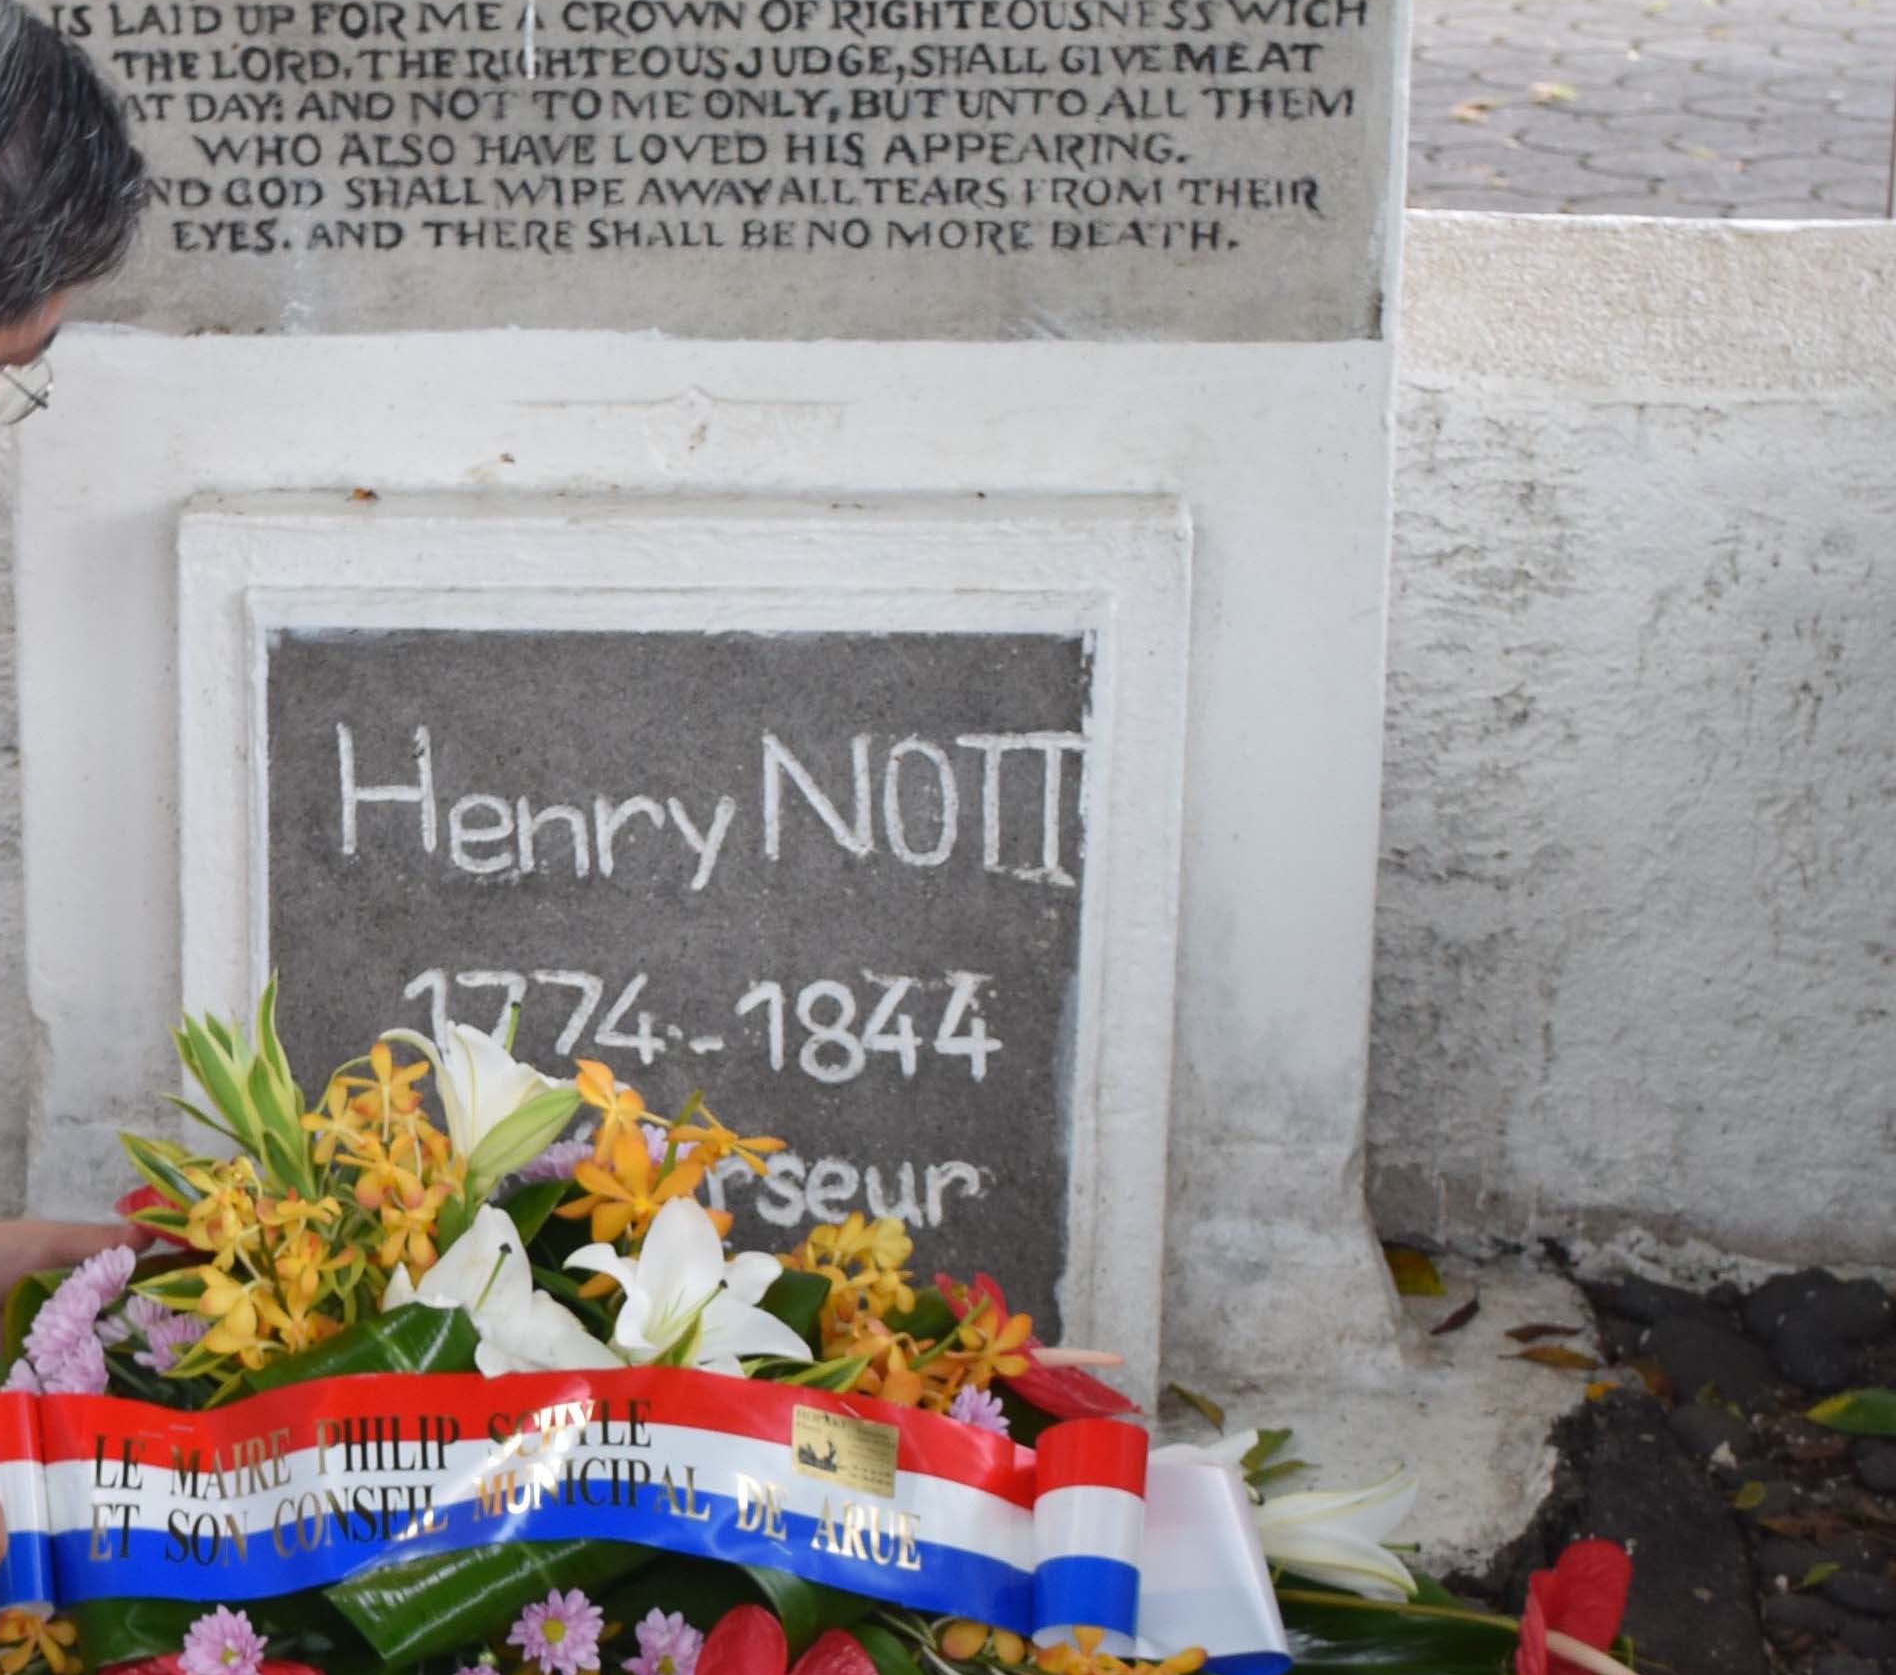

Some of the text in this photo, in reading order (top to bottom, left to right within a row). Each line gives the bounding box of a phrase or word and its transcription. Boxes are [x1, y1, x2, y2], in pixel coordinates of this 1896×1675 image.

[51, 4, 92, 37] IS
[109, 2, 222, 38] LAID
[310, 1, 407, 41] FOR
[419, 2, 502, 33] ME
[112, 49, 199, 84] THE
[358, 48, 461, 80] THE
[469, 44, 727, 82] RIGHTEOUS
[735, 44, 903, 84] JUDGE,
[910, 43, 1047, 78] SHALL
[1060, 44, 1162, 75] GIVE
[296, 90, 393, 123] AND
[410, 90, 518, 121] NOT
[533, 89, 602, 121] TO
[611, 90, 690, 119] ME
[849, 88, 946, 121] BUT
[957, 88, 1087, 120] UNTO
[1096, 86, 1187, 118] ALL
[1201, 86, 1355, 120] THEM
[191, 130, 1190, 173] WHO ALSO HAVE LOVED HIS APPEARING.
[224, 174, 1325, 218] GOD SHALL WIPE AWAY ALL TEARS FROM THEIR
[173, 217, 1240, 254] EYES. AND THERE SHALL NO MORE DEATH.
[336, 722, 1094, 891] Henry NOTT
[92, 1435, 143, 1491] LE
[170, 1428, 291, 1500] MAIRE
[316, 1412, 461, 1477] PHILIP
[89, 1459, 921, 1571] ET SON CONSEIL MUNICIPAL DE ARUE
